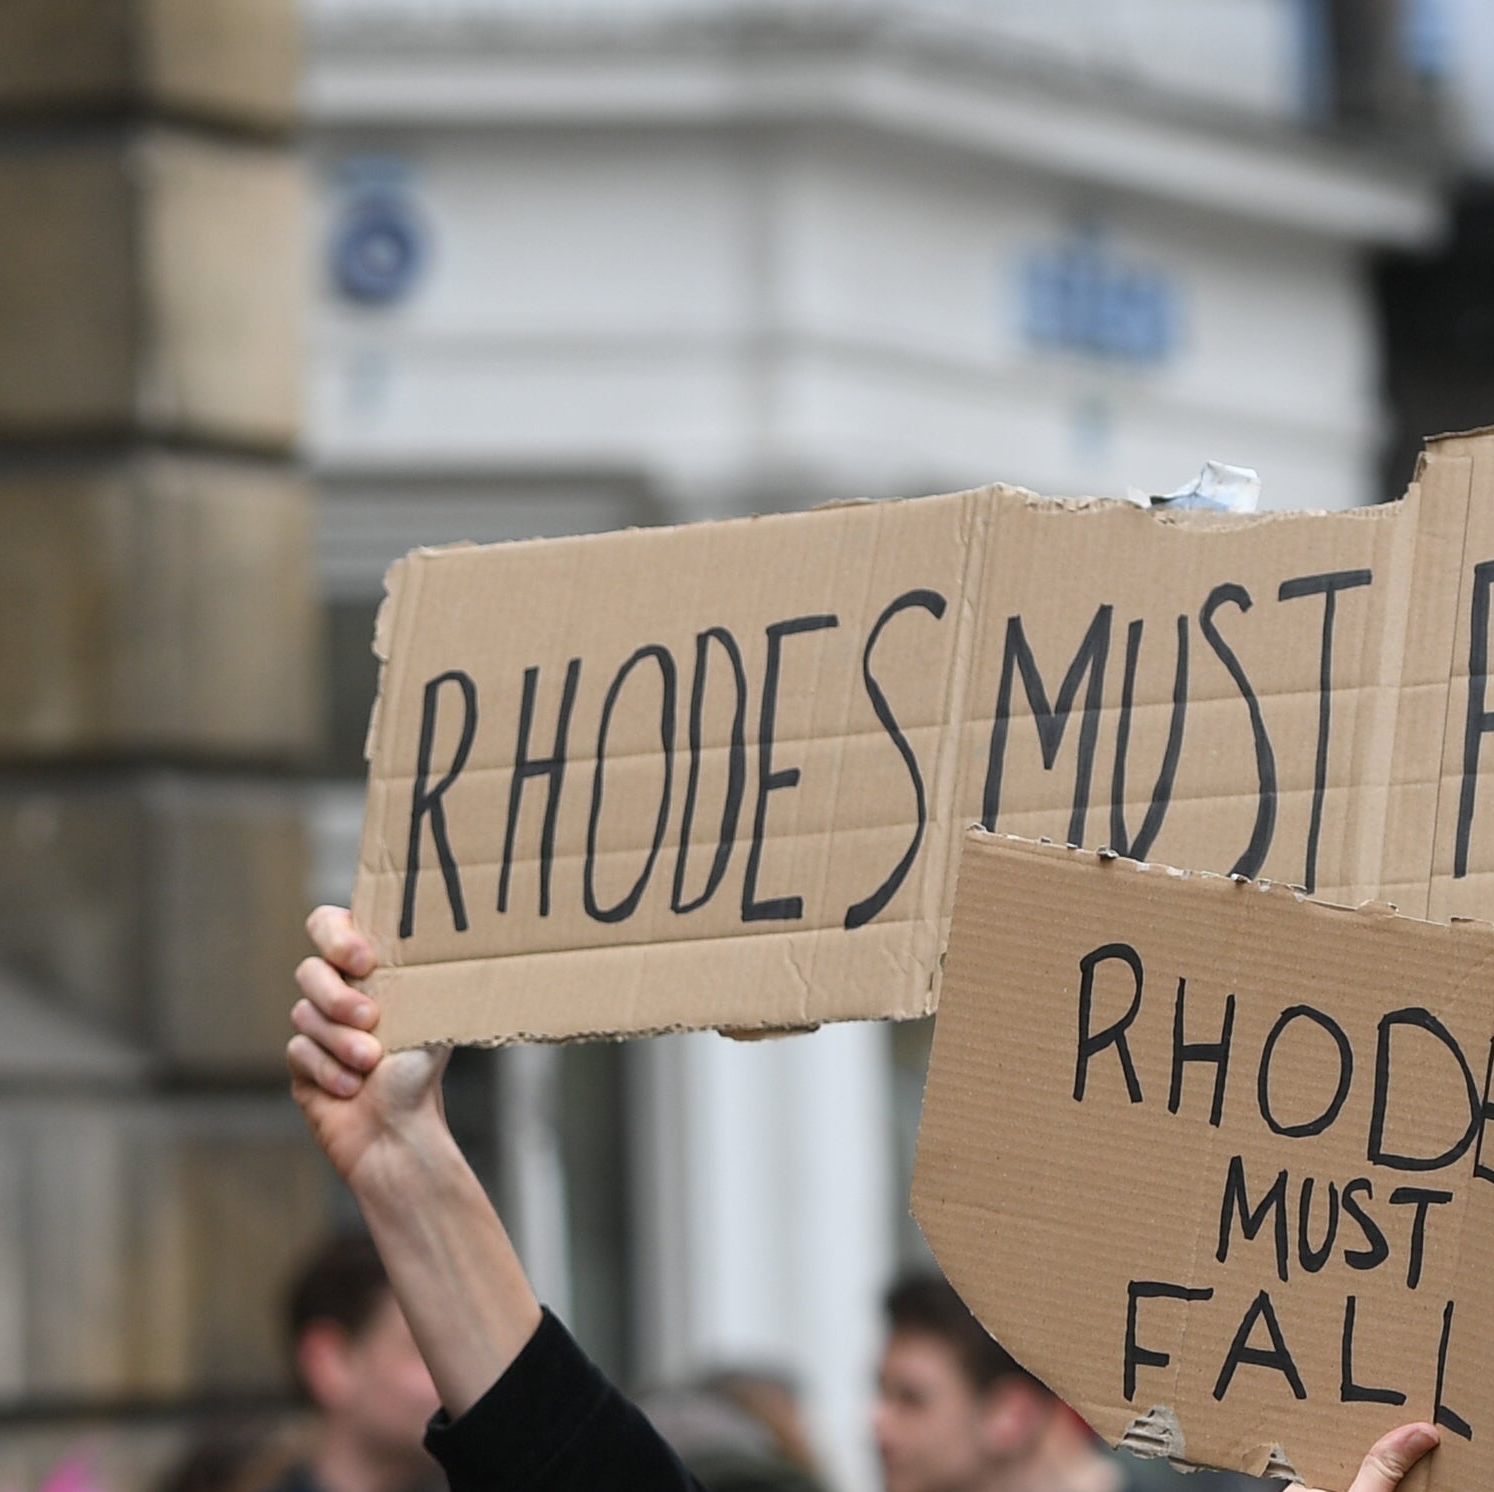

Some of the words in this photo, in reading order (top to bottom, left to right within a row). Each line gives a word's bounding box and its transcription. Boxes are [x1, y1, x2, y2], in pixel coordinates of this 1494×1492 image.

[397, 588, 950, 939] RHODES
[982, 567, 1373, 894] MUST
[1215, 1155, 1453, 1289] MUST
[1123, 1281, 1473, 1441] FALL
